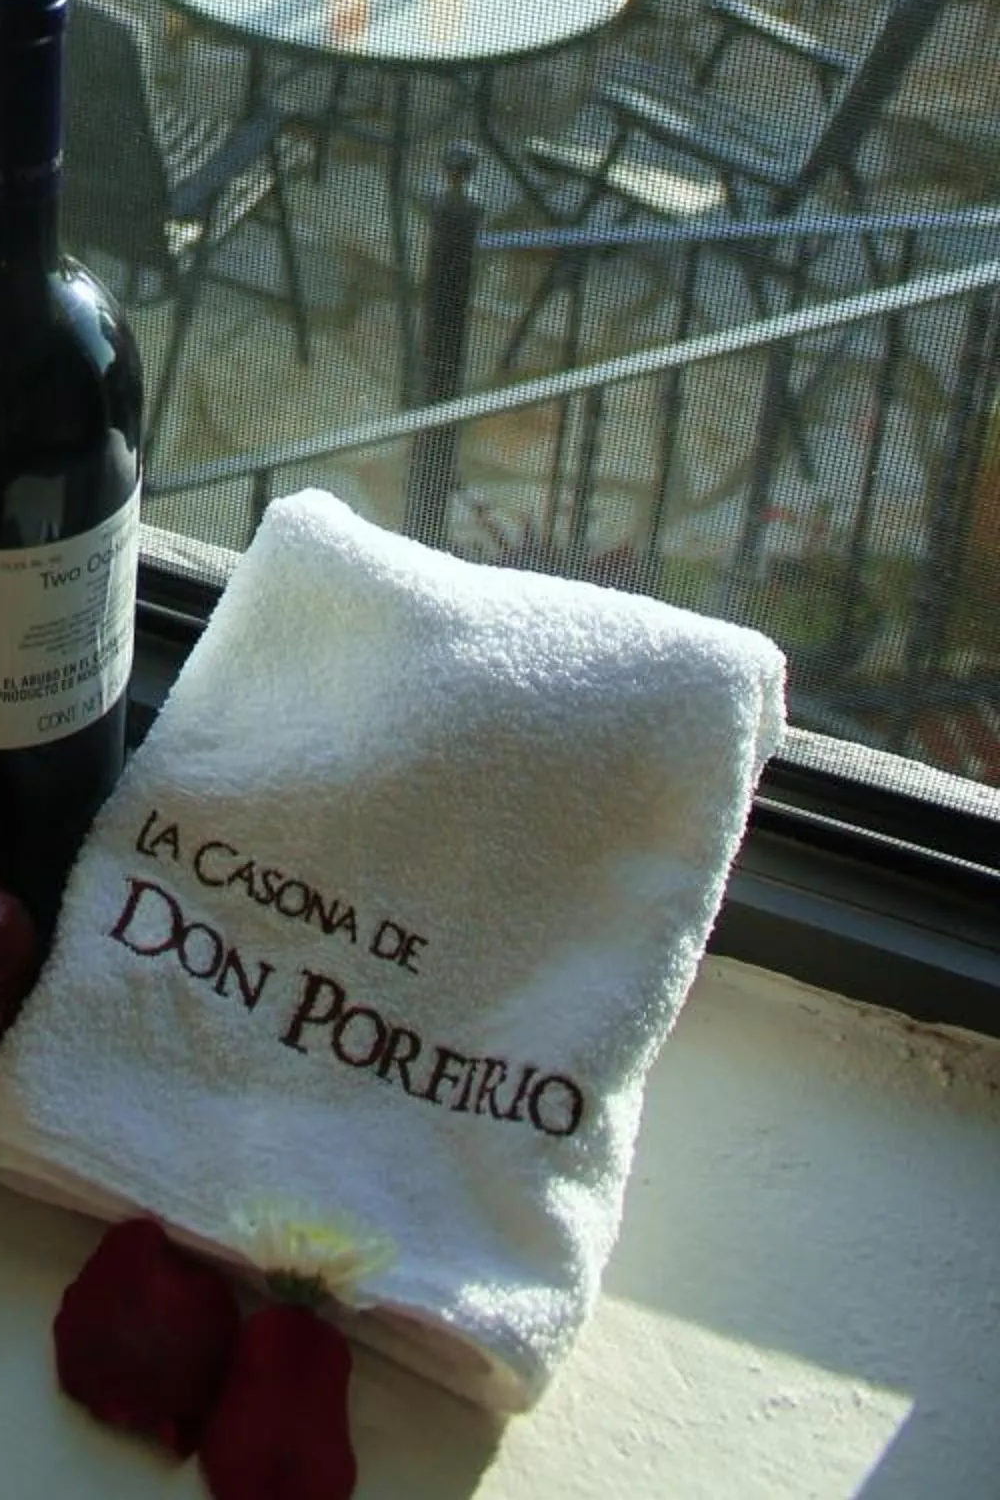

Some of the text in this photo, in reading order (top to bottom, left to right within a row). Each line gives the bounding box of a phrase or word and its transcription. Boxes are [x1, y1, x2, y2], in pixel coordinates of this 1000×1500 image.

[40, 566, 81, 590] Two
[136, 809, 429, 975] LA CASONA DE
[108, 876, 586, 1137] DON PORFIRIO
